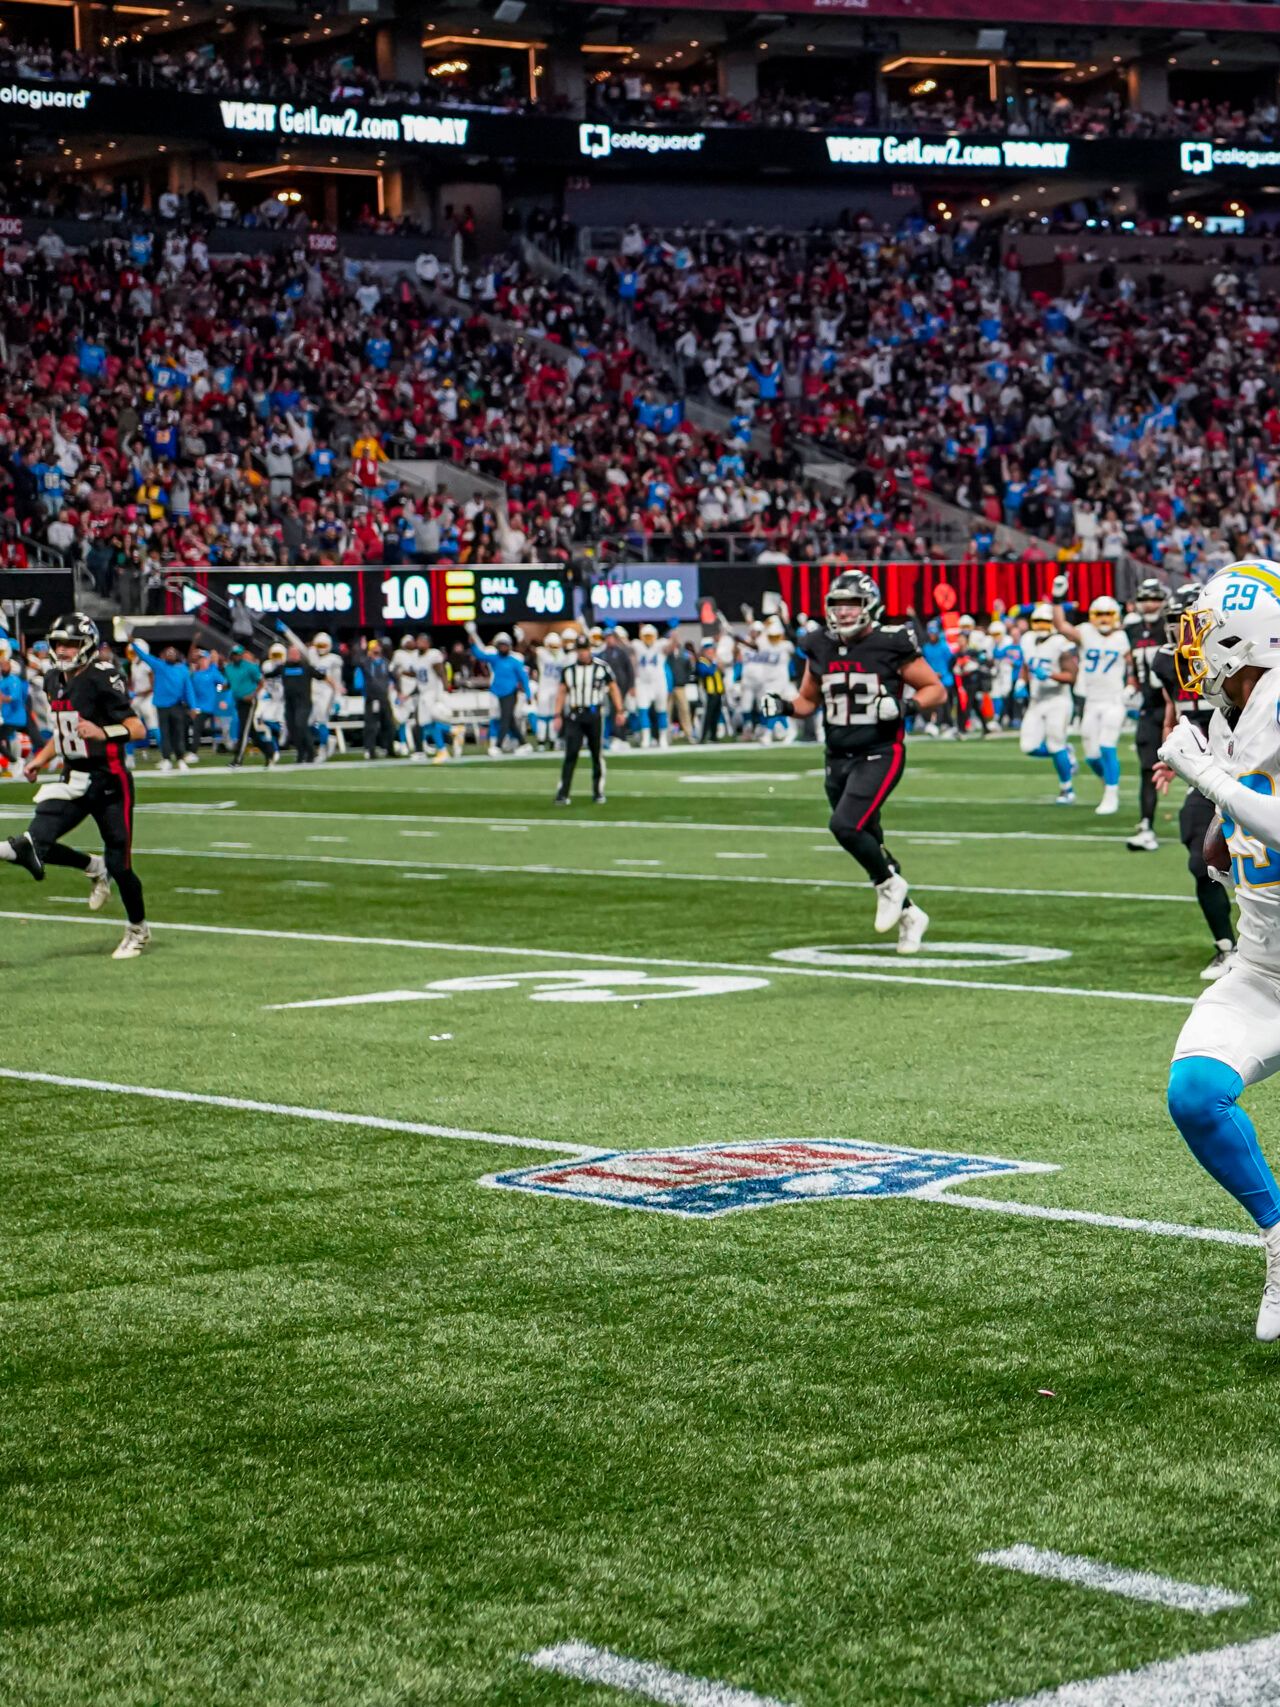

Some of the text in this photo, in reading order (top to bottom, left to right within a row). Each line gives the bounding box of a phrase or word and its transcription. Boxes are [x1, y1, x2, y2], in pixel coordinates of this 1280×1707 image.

[219, 101, 468, 144] VISIT GetLow2.com TODAY
[610, 130, 701, 153] cologuard
[826, 136, 881, 163] VISIT
[1002, 141, 1069, 168] TODAY
[381, 575, 430, 620] 10
[481, 578, 518, 595] BALL
[526, 580, 564, 614] 40
[1221, 583, 1260, 611] 29
[481, 597, 505, 614] ON
[828, 661, 867, 673] ATL
[1085, 649, 1119, 673] 97
[821, 672, 880, 727] 63
